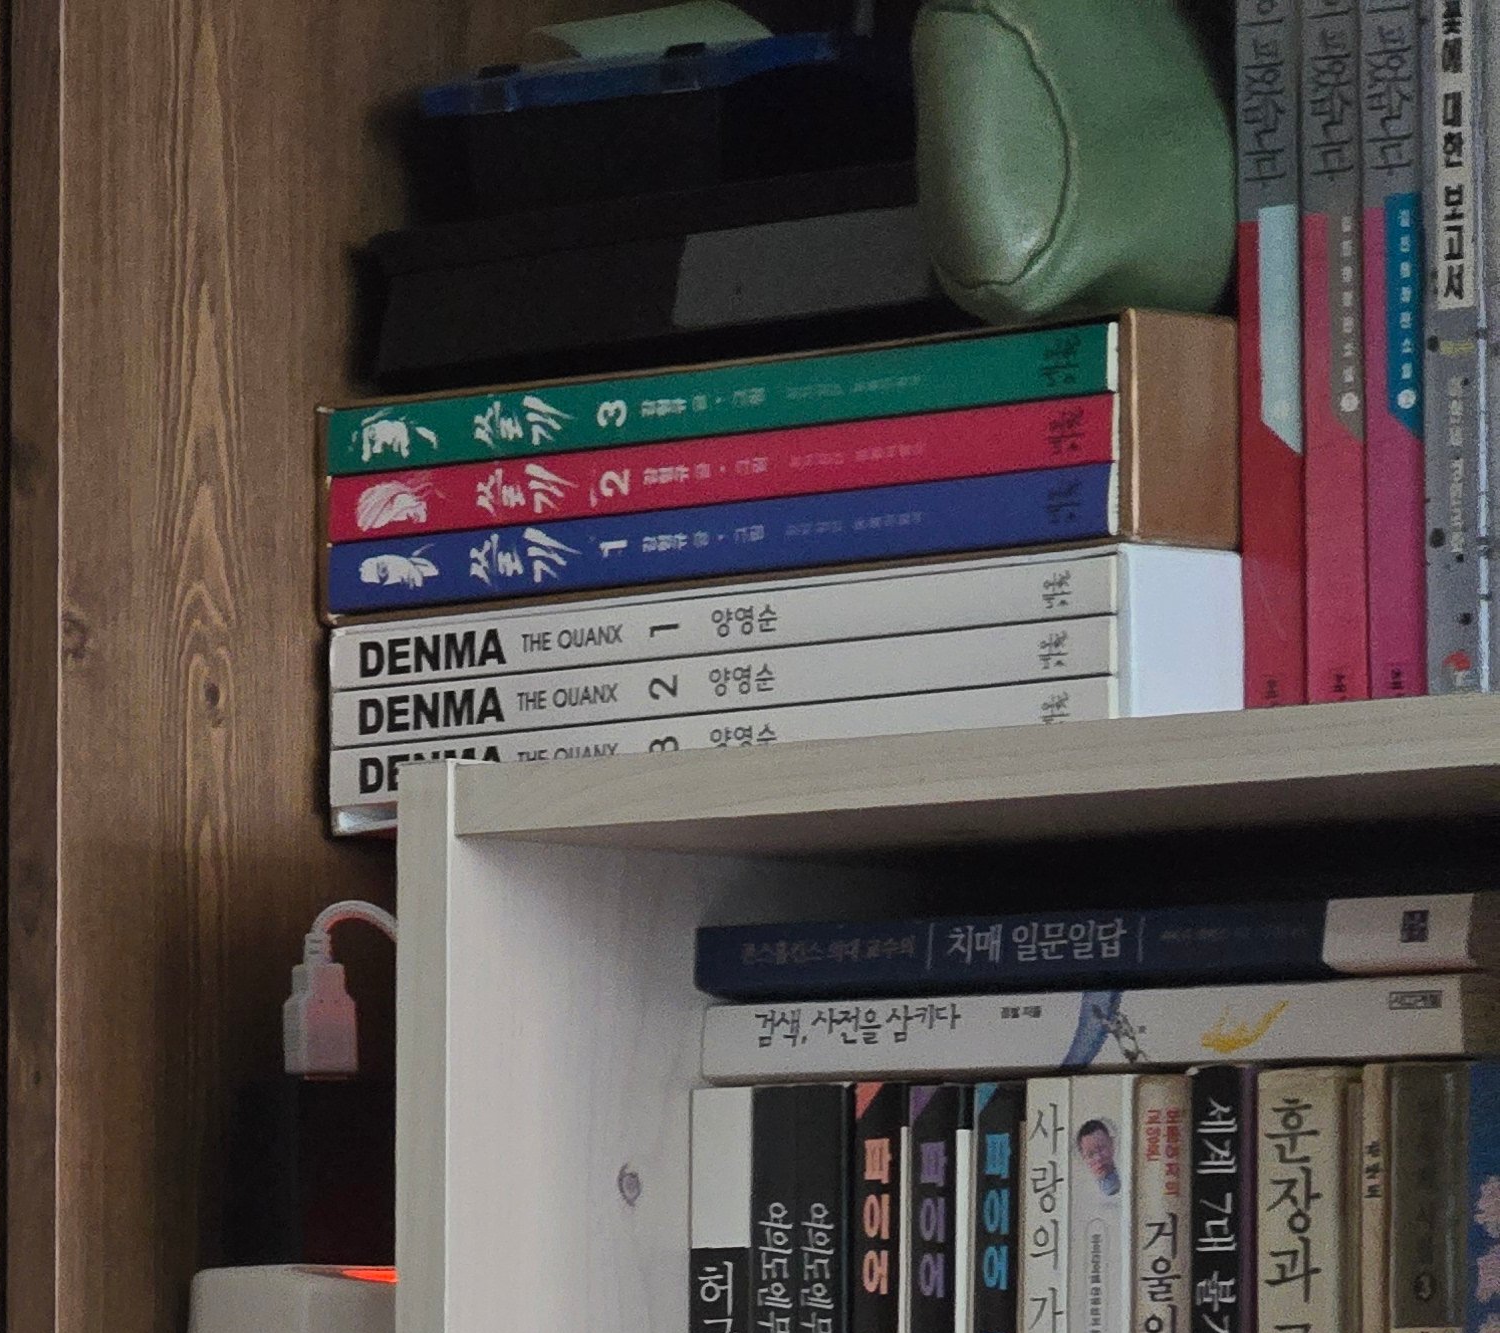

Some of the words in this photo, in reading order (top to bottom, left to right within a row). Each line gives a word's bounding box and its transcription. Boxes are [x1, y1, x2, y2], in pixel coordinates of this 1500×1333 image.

[597, 401, 627, 428] 3
[600, 468, 631, 498] 2
[600, 538, 628, 557] 1
[359, 628, 506, 678] DENMA
[521, 631, 553, 654] THE
[650, 623, 679, 638] 1
[711, 604, 778, 638] 양영순
[358, 687, 505, 735] DENMA
[517, 690, 547, 712] THE
[649, 674, 679, 698] 2
[708, 663, 777, 697] 양영순
[948, 924, 1001, 964] 치매
[1012, 918, 1127, 961] 일문일답
[755, 1010, 806, 1048] 검색,
[811, 1006, 882, 1045] 사전을
[886, 1003, 961, 1043] 삼키다
[1196, 1099, 1238, 1174] 세계
[1029, 1102, 1064, 1270] 사랑의
[1264, 1098, 1322, 1302] 훈장과
[1196, 1192, 1238, 1252] 7대
